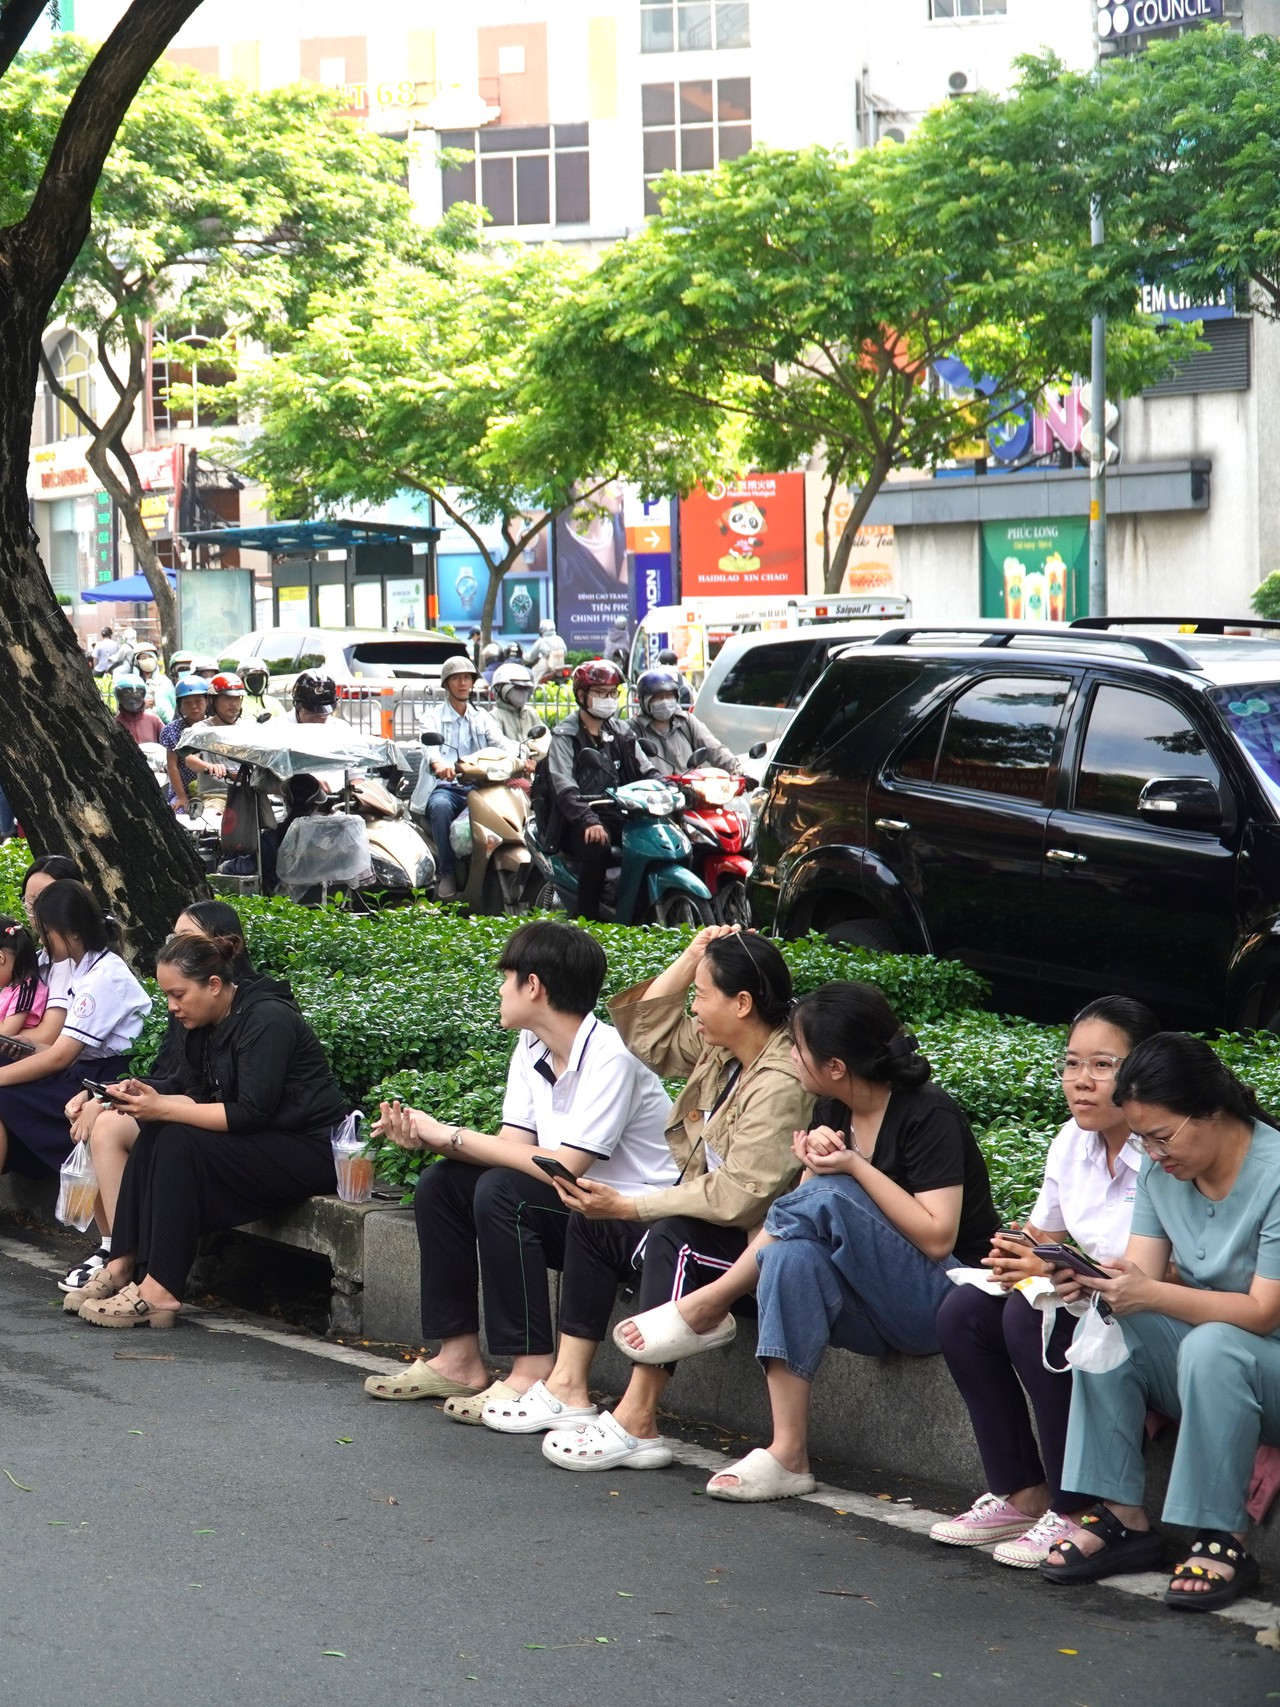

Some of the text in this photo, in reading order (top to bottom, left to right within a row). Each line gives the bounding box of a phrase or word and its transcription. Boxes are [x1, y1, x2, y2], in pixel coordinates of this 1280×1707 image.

[1133, 0, 1211, 27] COUNCIL
[1007, 523, 1059, 540] PHÚC LONG
[698, 574, 740, 583] HAIDILAO
[743, 573, 759, 582] XIN
